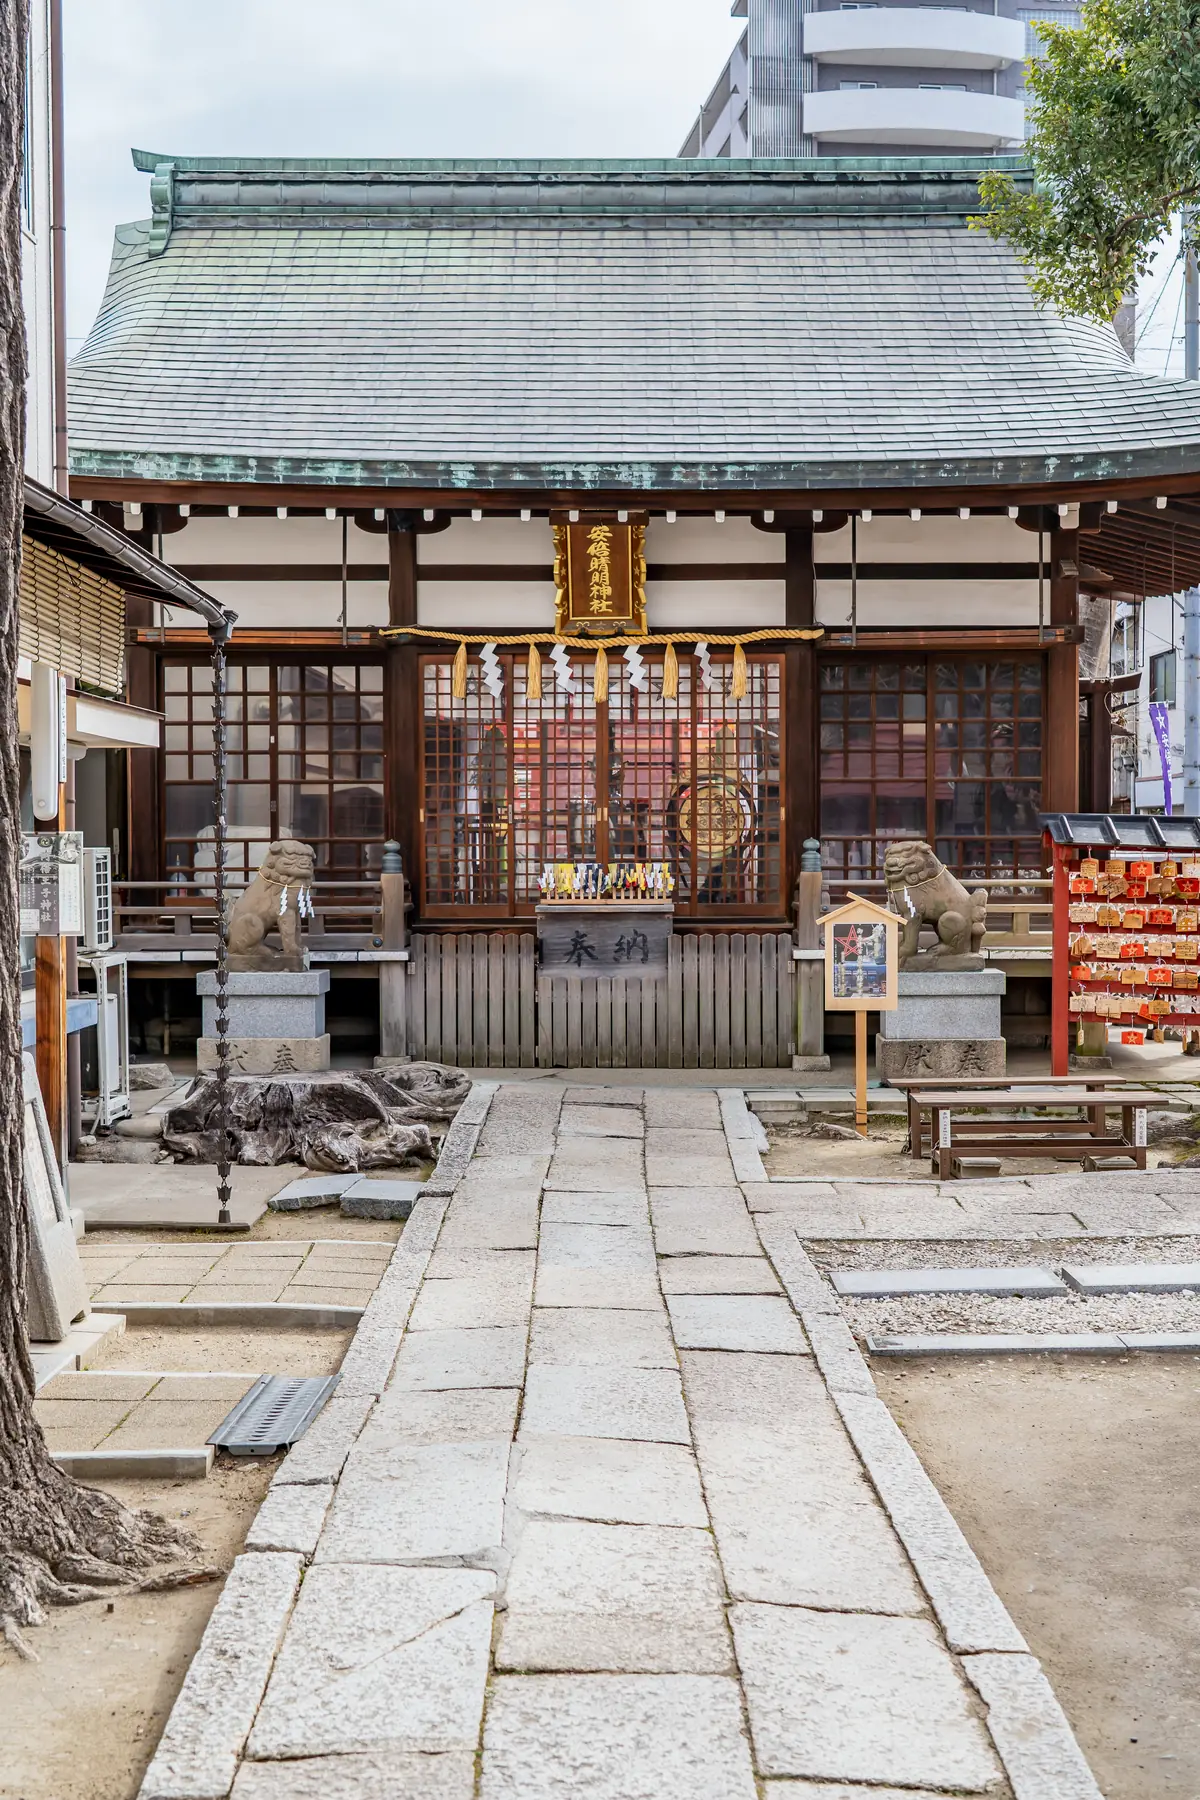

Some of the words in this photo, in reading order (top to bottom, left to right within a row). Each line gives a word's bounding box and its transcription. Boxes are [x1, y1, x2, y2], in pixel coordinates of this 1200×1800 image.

[586, 525, 613, 614] 安倍晴明神社
[563, 929, 649, 967] 奉納
